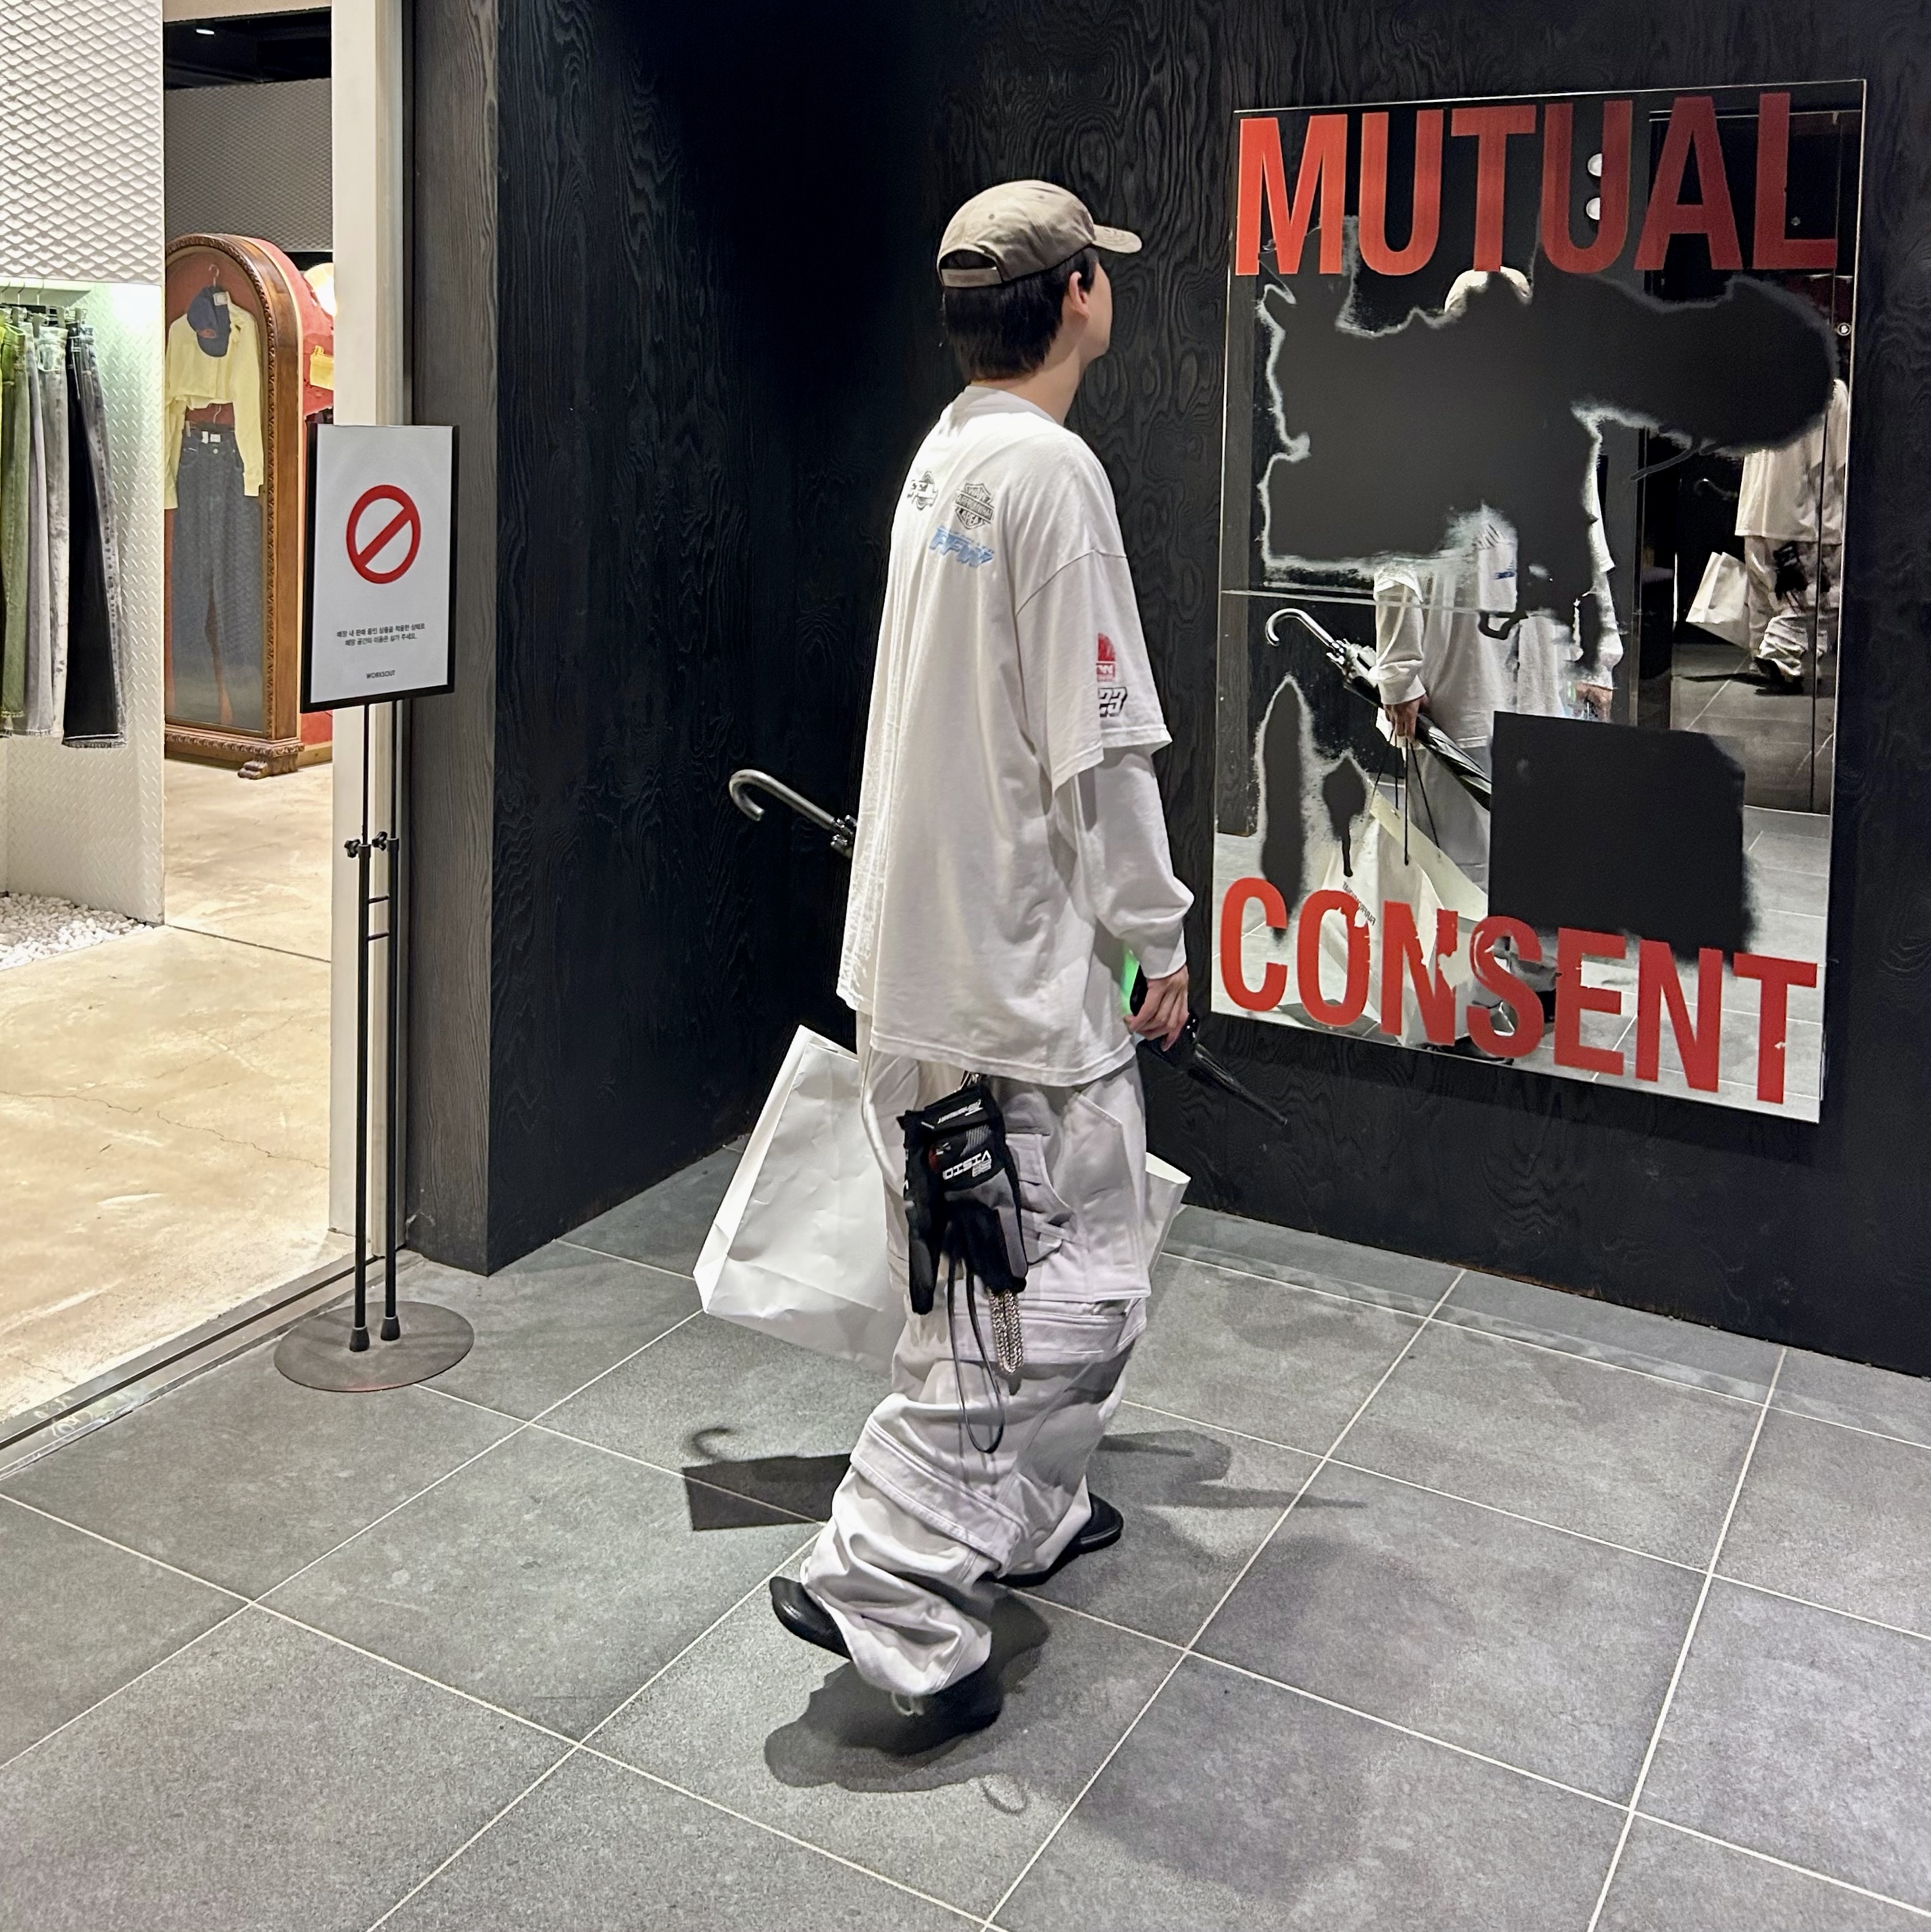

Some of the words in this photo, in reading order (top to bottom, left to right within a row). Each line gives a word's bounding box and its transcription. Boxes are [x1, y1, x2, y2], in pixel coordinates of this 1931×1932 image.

[1235, 91, 1838, 276] MUTUAL
[366, 669, 395, 679] WORKSOUT
[1219, 877, 1818, 1105] CONSENT
